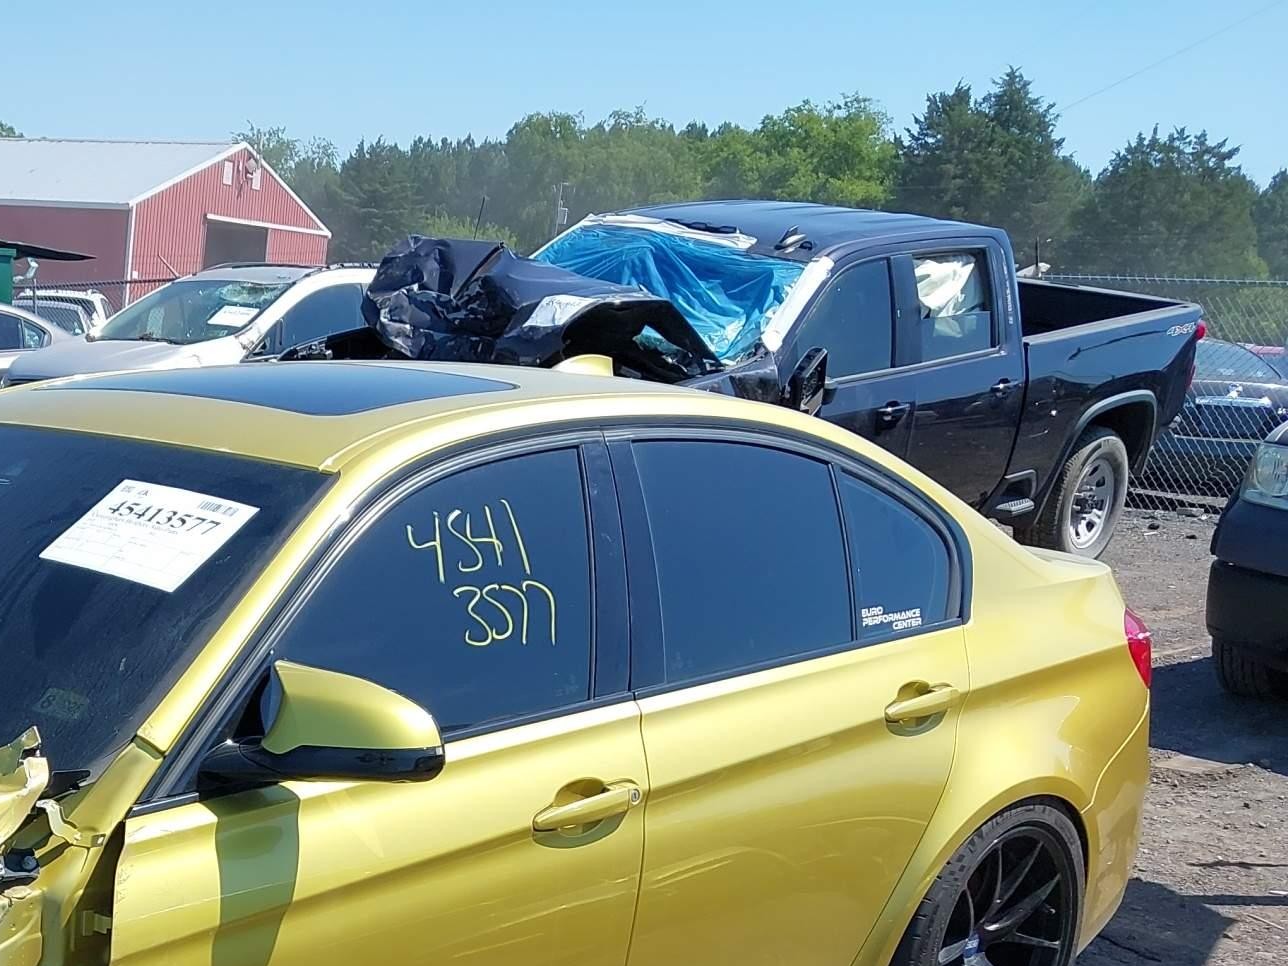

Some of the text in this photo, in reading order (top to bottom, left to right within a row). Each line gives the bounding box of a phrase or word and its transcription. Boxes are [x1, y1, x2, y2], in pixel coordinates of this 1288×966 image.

[108, 500, 221, 535] 45413577
[406, 499, 531, 585] 4541
[861, 606, 884, 618] EURO
[862, 608, 921, 627] PERFORMANCE
[892, 617, 922, 630] CENTER
